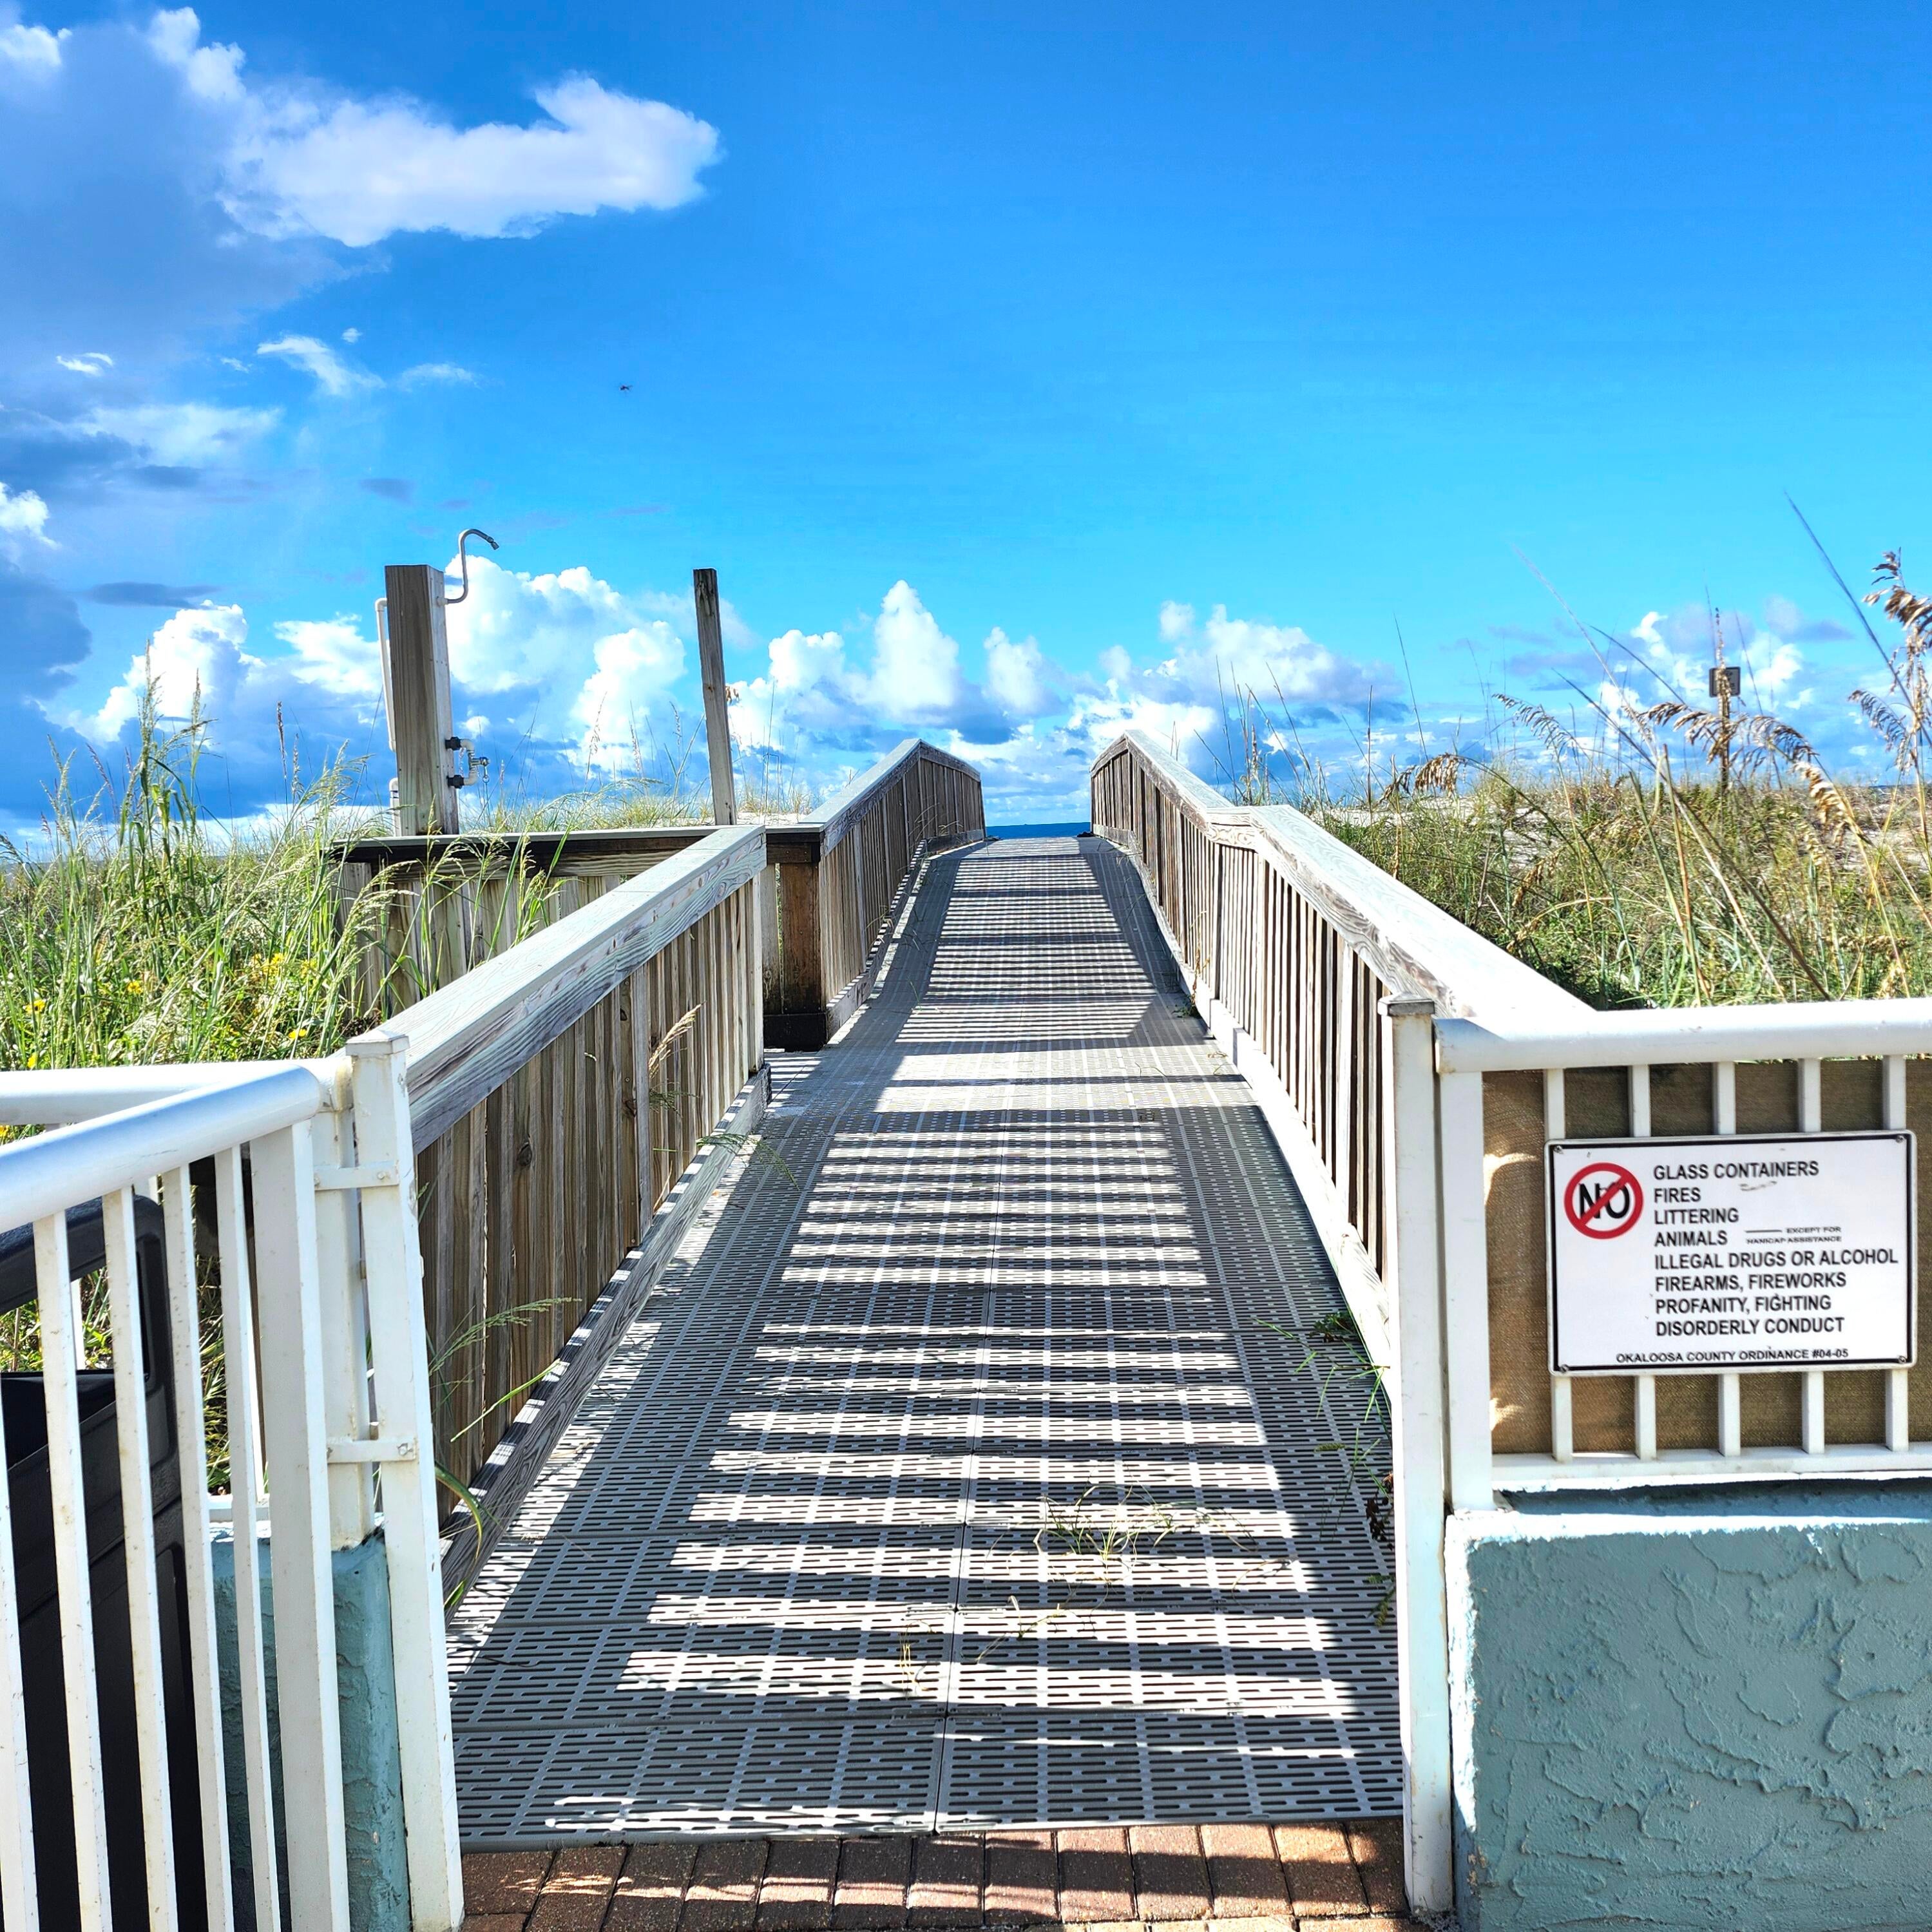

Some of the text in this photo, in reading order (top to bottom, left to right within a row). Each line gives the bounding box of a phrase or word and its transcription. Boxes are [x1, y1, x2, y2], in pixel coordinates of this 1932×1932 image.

[1654, 1161, 1819, 1180] GLASS CONTAINERS
[1579, 1183, 1630, 1219] NO
[1654, 1187, 1701, 1203] FIRES
[1654, 1208, 1738, 1224] LITTERING
[1655, 1230, 1727, 1246] ANIMALS
[1656, 1249, 1898, 1269] ILLEGAL DRUGS OR ALCOHOL
[1656, 1272, 1846, 1292] FIREARMS, FIREWORKS
[1656, 1295, 1831, 1315] PROFANITY, FIGHTING
[1657, 1317, 1844, 1336] DISORDERLY CONDUCT
[1616, 1349, 1848, 1364] OKALOOSA COUNTY ORDINANCE #04-05
